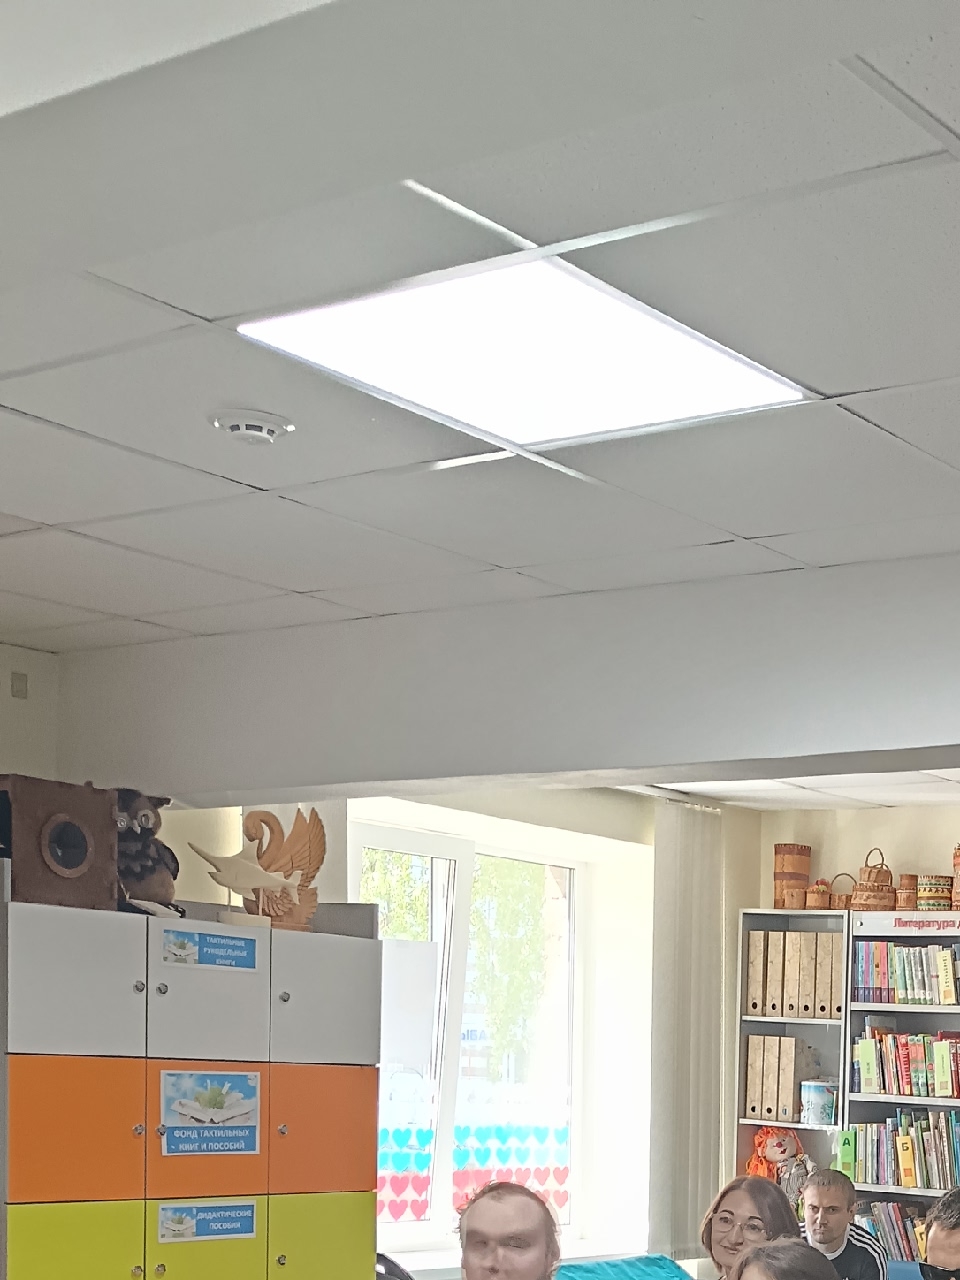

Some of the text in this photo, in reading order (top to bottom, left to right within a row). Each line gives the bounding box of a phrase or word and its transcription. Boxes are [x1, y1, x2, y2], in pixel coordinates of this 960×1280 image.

[893, 917, 955, 931] Литература
[173, 1128, 250, 1139] ФОНД ТАКТИЛЬНЫХ
[178, 1142, 199, 1151] КНИГ
[208, 1140, 245, 1151] ПОСОБИЙ
[842, 1137, 851, 1147] А
[901, 1141, 910, 1152] Б
[196, 1209, 253, 1220] ДИДАКТИЧЕСКИЕ
